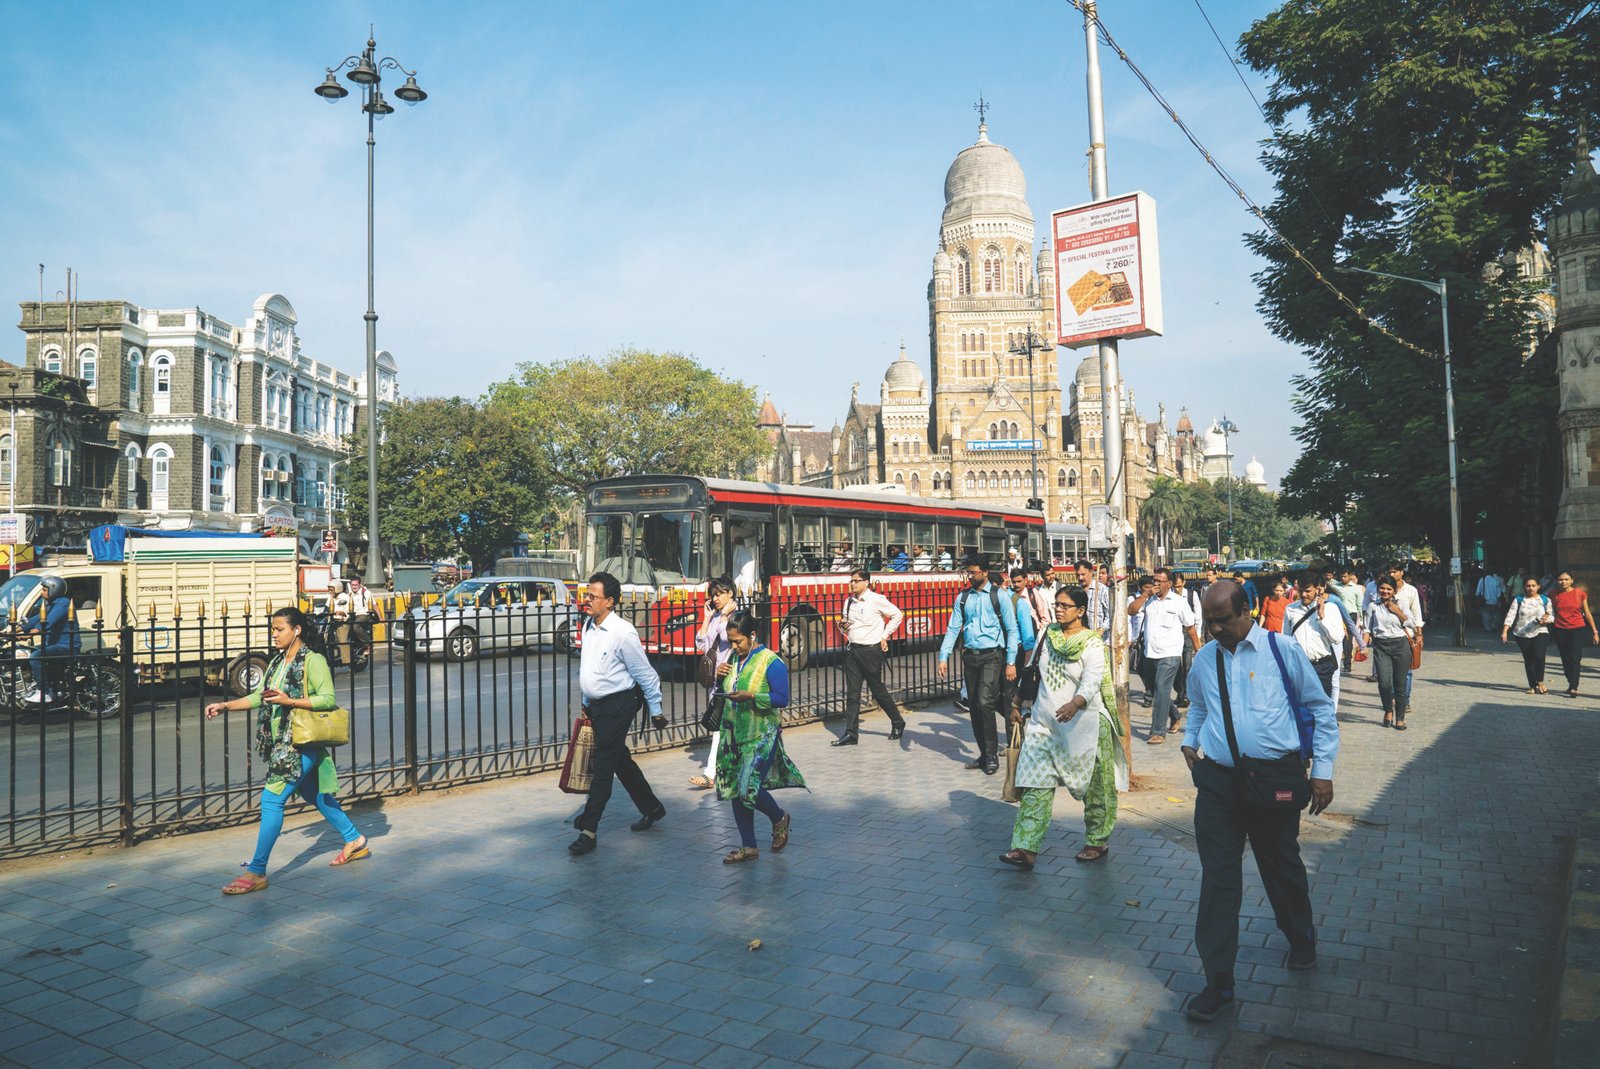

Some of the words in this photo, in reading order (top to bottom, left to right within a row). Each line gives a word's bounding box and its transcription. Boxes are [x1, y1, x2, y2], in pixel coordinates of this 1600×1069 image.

[1068, 254, 1087, 262] SPECIAL
[1089, 249, 1111, 258] FESTIVAL
[1113, 245, 1128, 253] OFFER
[1113, 259, 1134, 268] 260/-
[269, 516, 294, 526] CAPITOL
